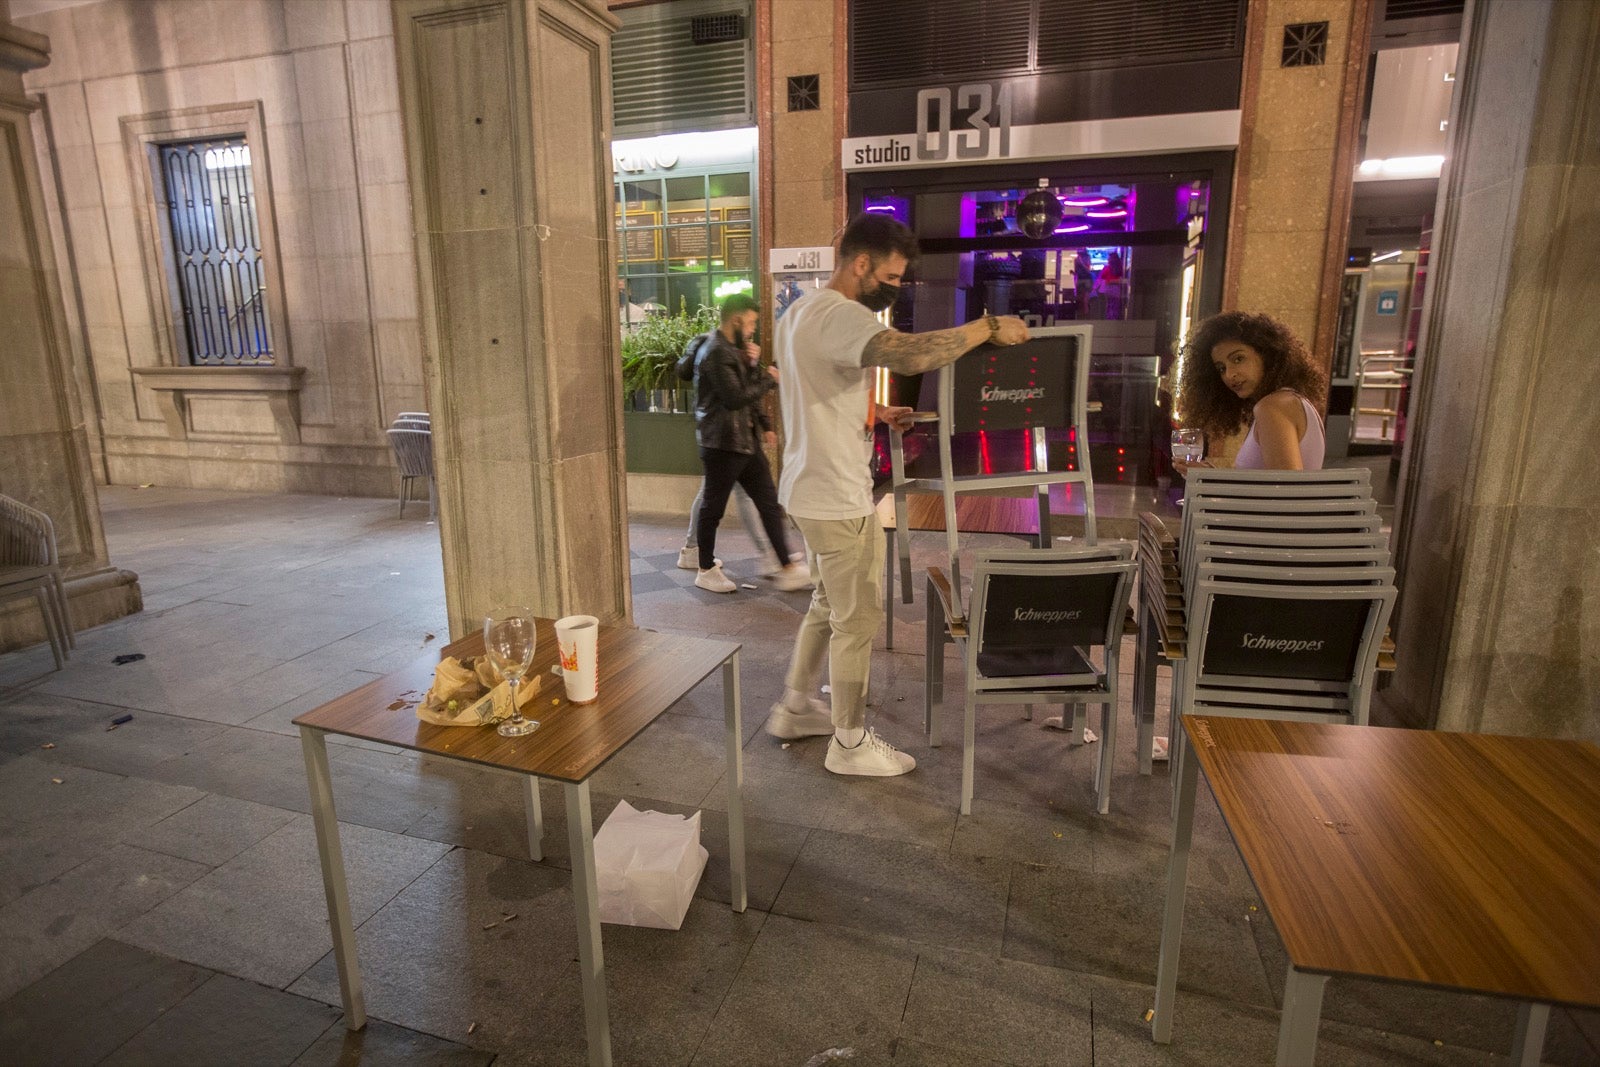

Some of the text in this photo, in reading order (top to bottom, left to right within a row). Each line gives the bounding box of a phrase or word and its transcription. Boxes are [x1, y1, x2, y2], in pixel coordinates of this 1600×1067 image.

[855, 83, 1013, 166] studio 031
[798, 251, 821, 269] 031
[980, 384, 1046, 403] Schweppes
[1013, 605, 1083, 625] Schweppes
[1240, 632, 1325, 653] Schweppes
